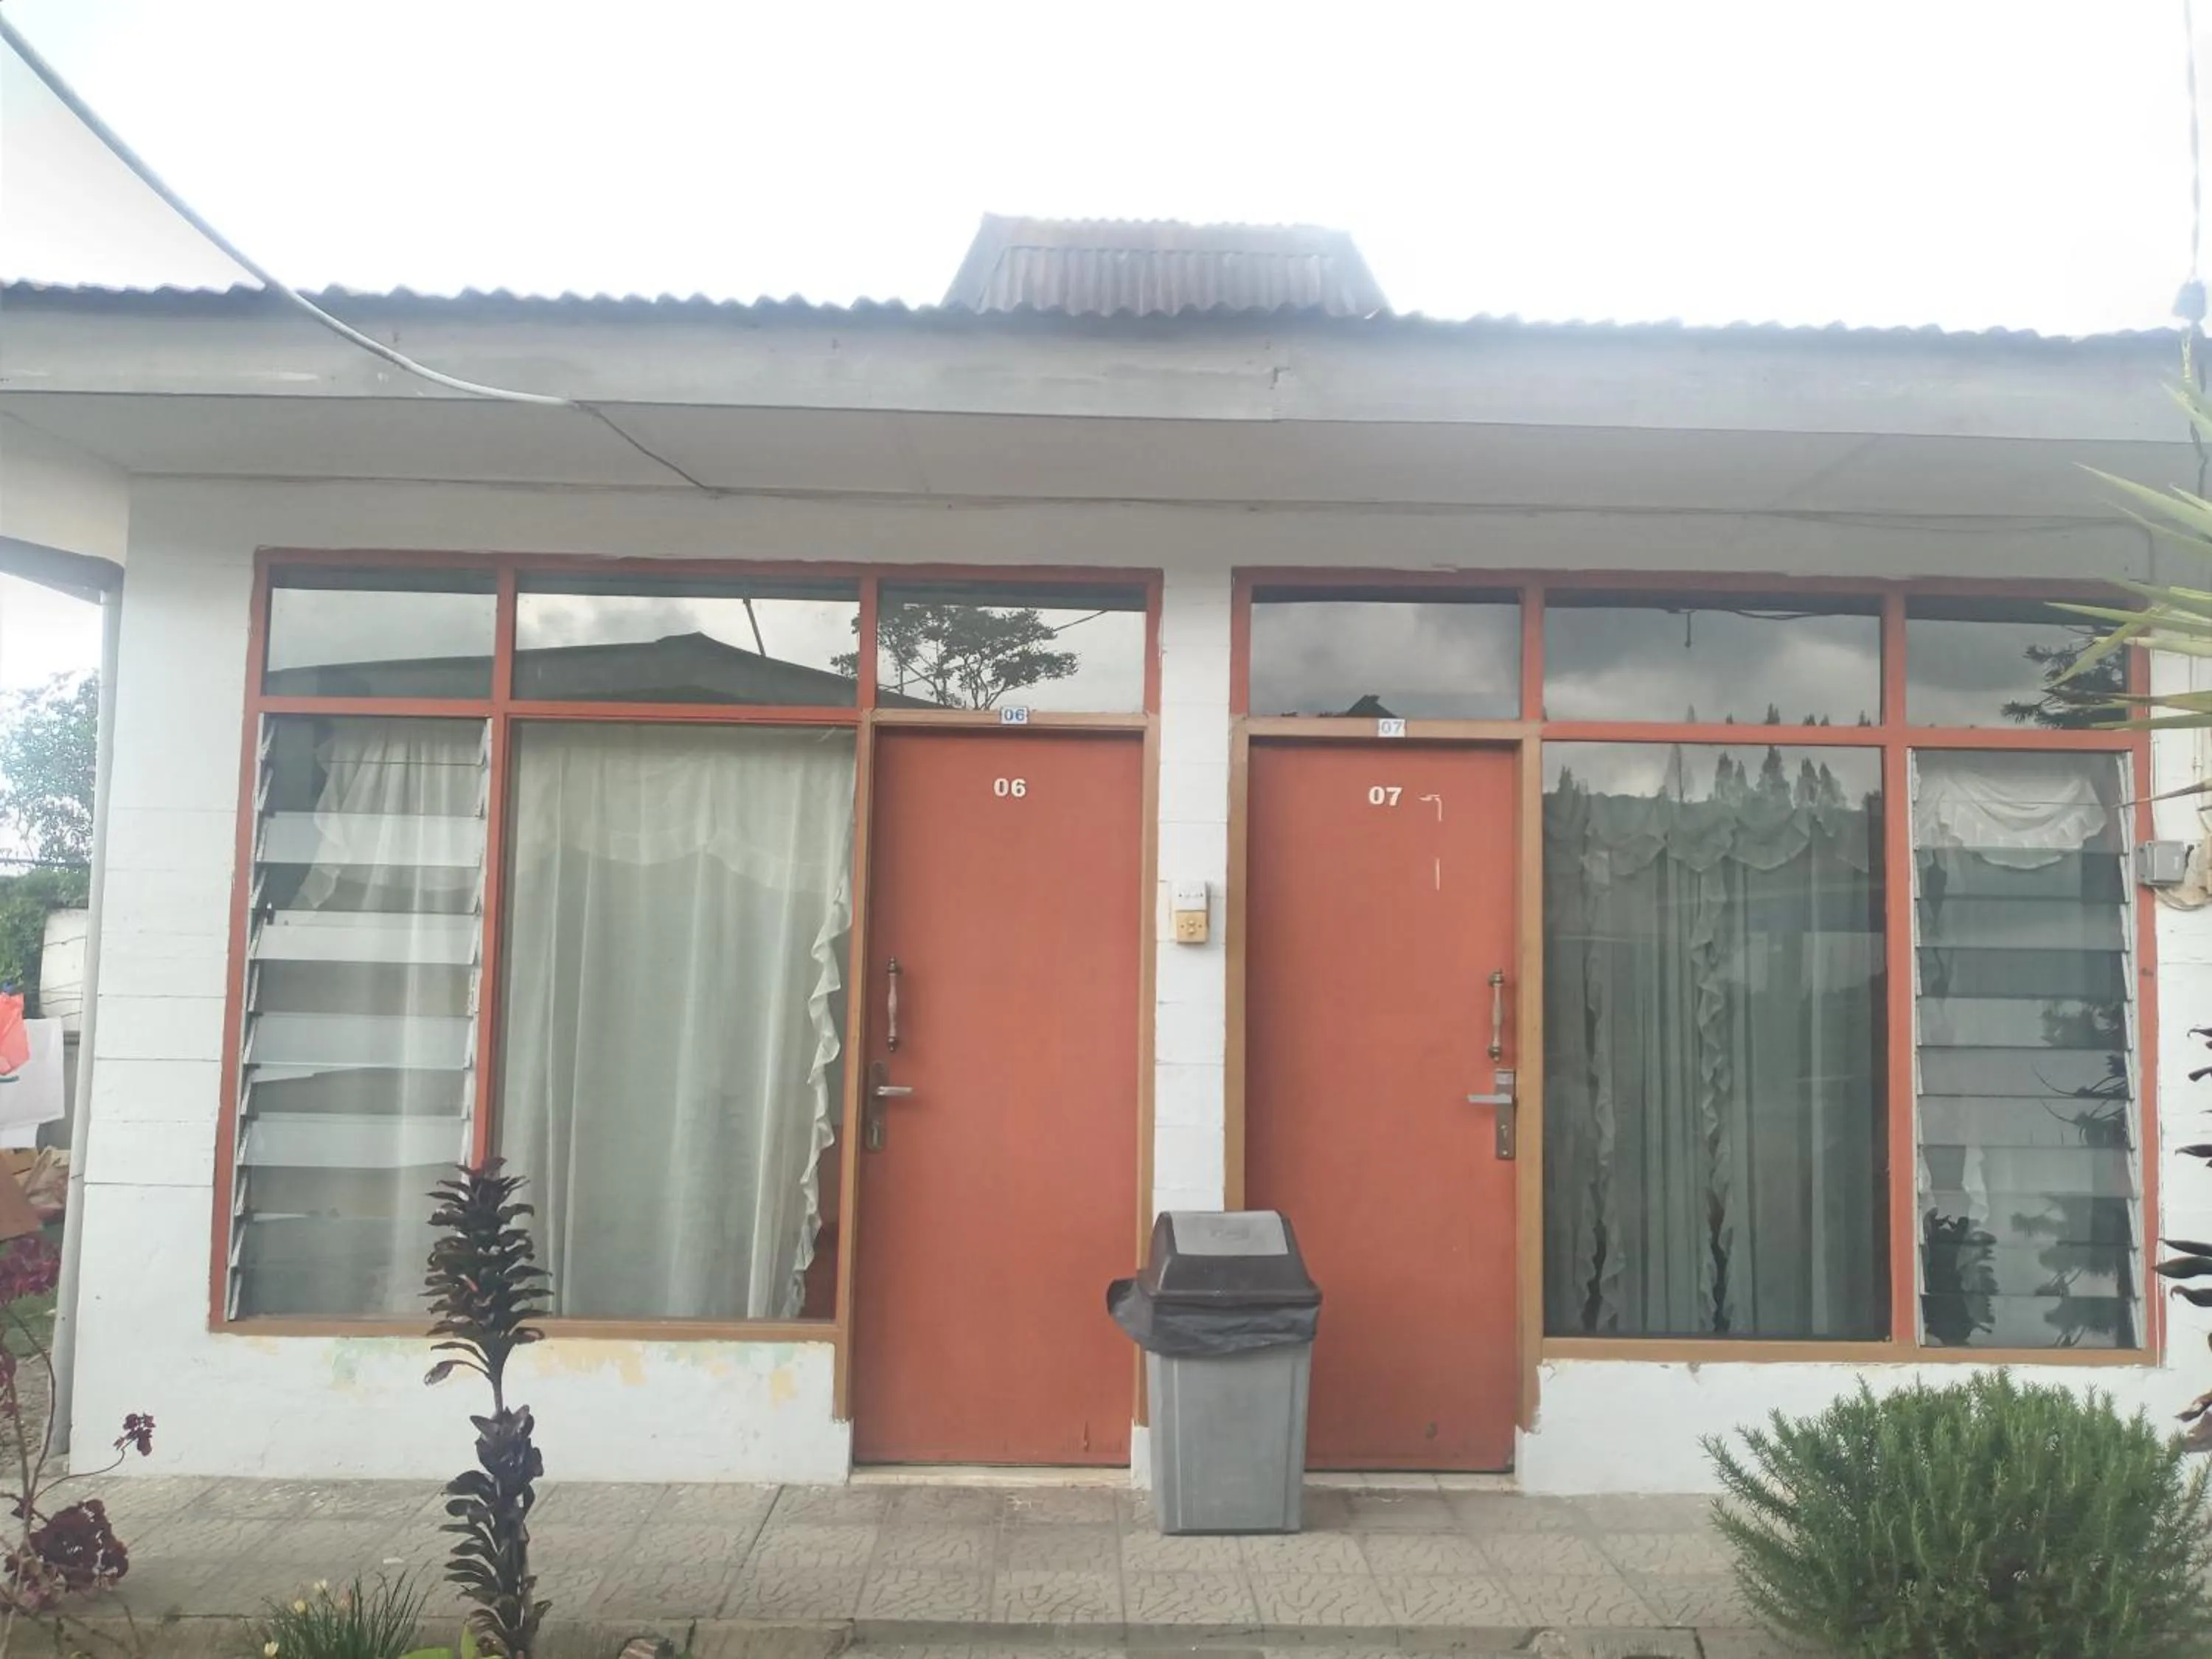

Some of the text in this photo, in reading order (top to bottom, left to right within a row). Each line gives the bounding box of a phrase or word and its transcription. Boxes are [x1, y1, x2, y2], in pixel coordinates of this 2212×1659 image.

[1004, 709, 1025, 721] 06
[1380, 720, 1403, 734] 07
[993, 777, 1026, 797] 06
[1368, 786, 1402, 806] 07
